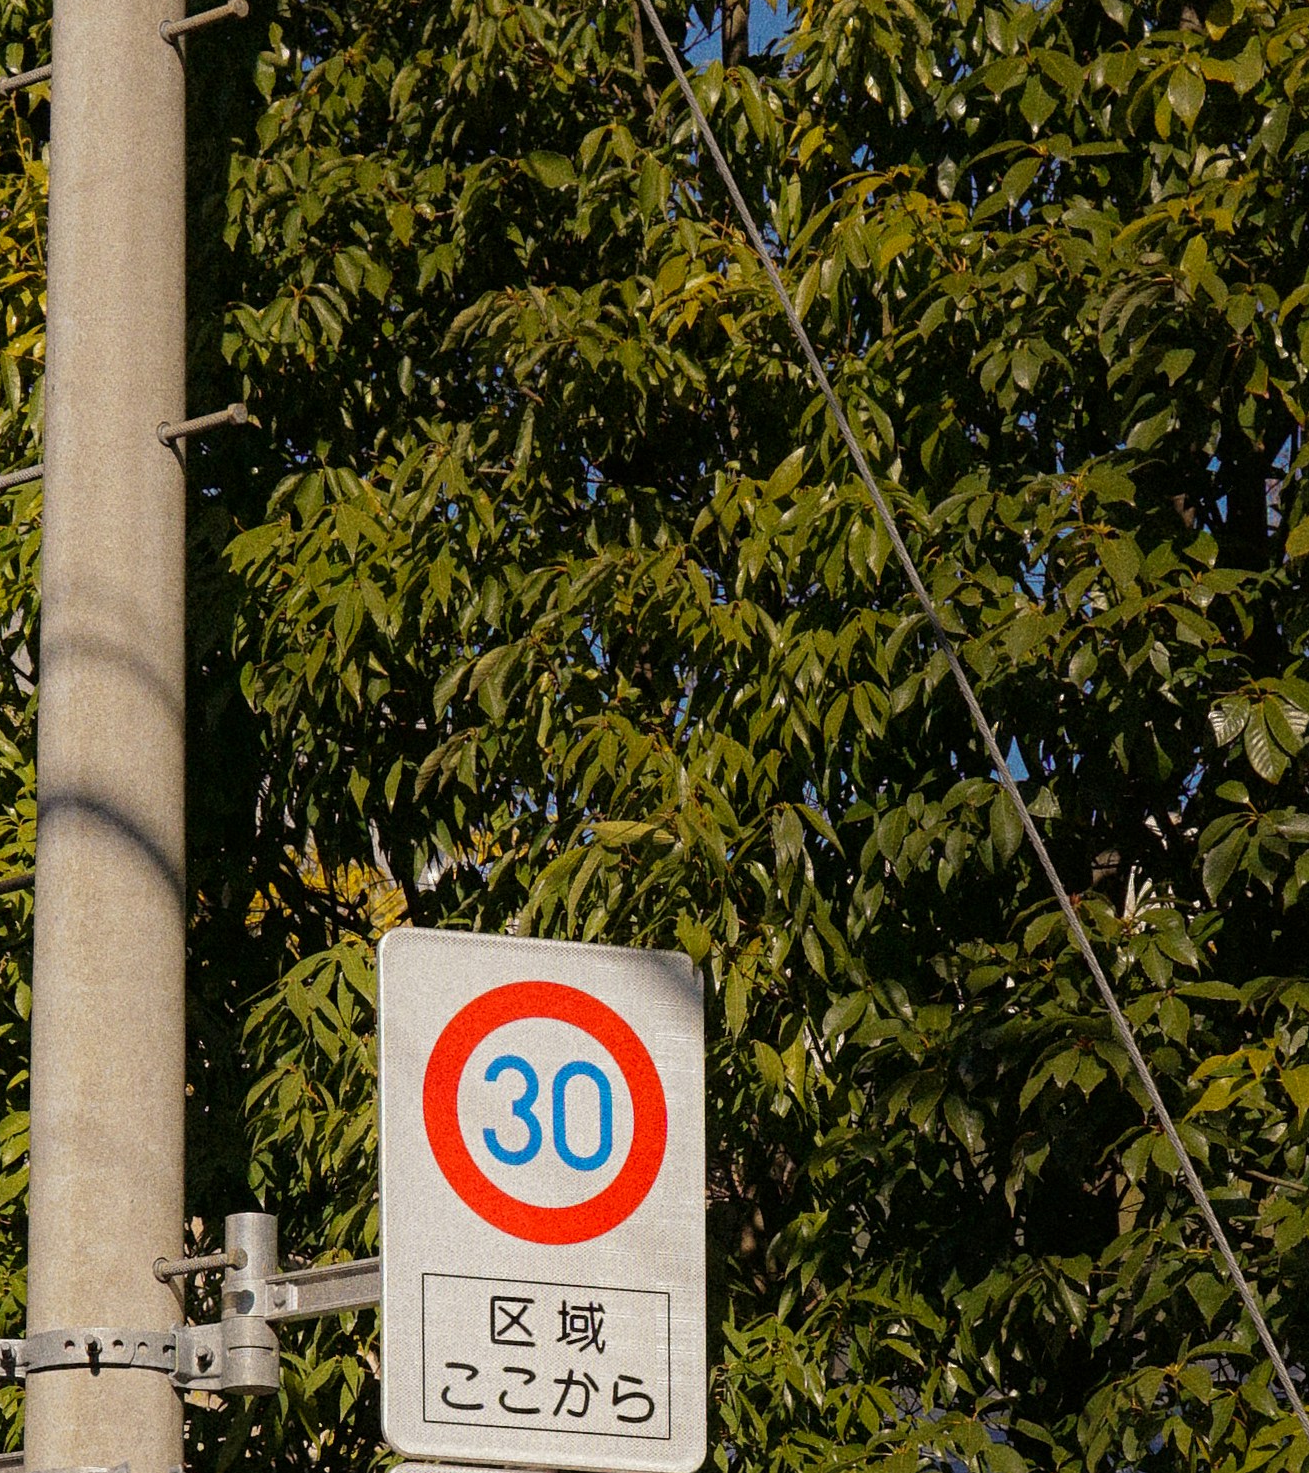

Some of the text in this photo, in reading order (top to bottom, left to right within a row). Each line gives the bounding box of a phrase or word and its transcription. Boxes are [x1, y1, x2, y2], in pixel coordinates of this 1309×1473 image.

[482, 1054, 613, 1172] 30
[491, 1295, 606, 1354] 区域
[440, 1361, 656, 1424] ここから
